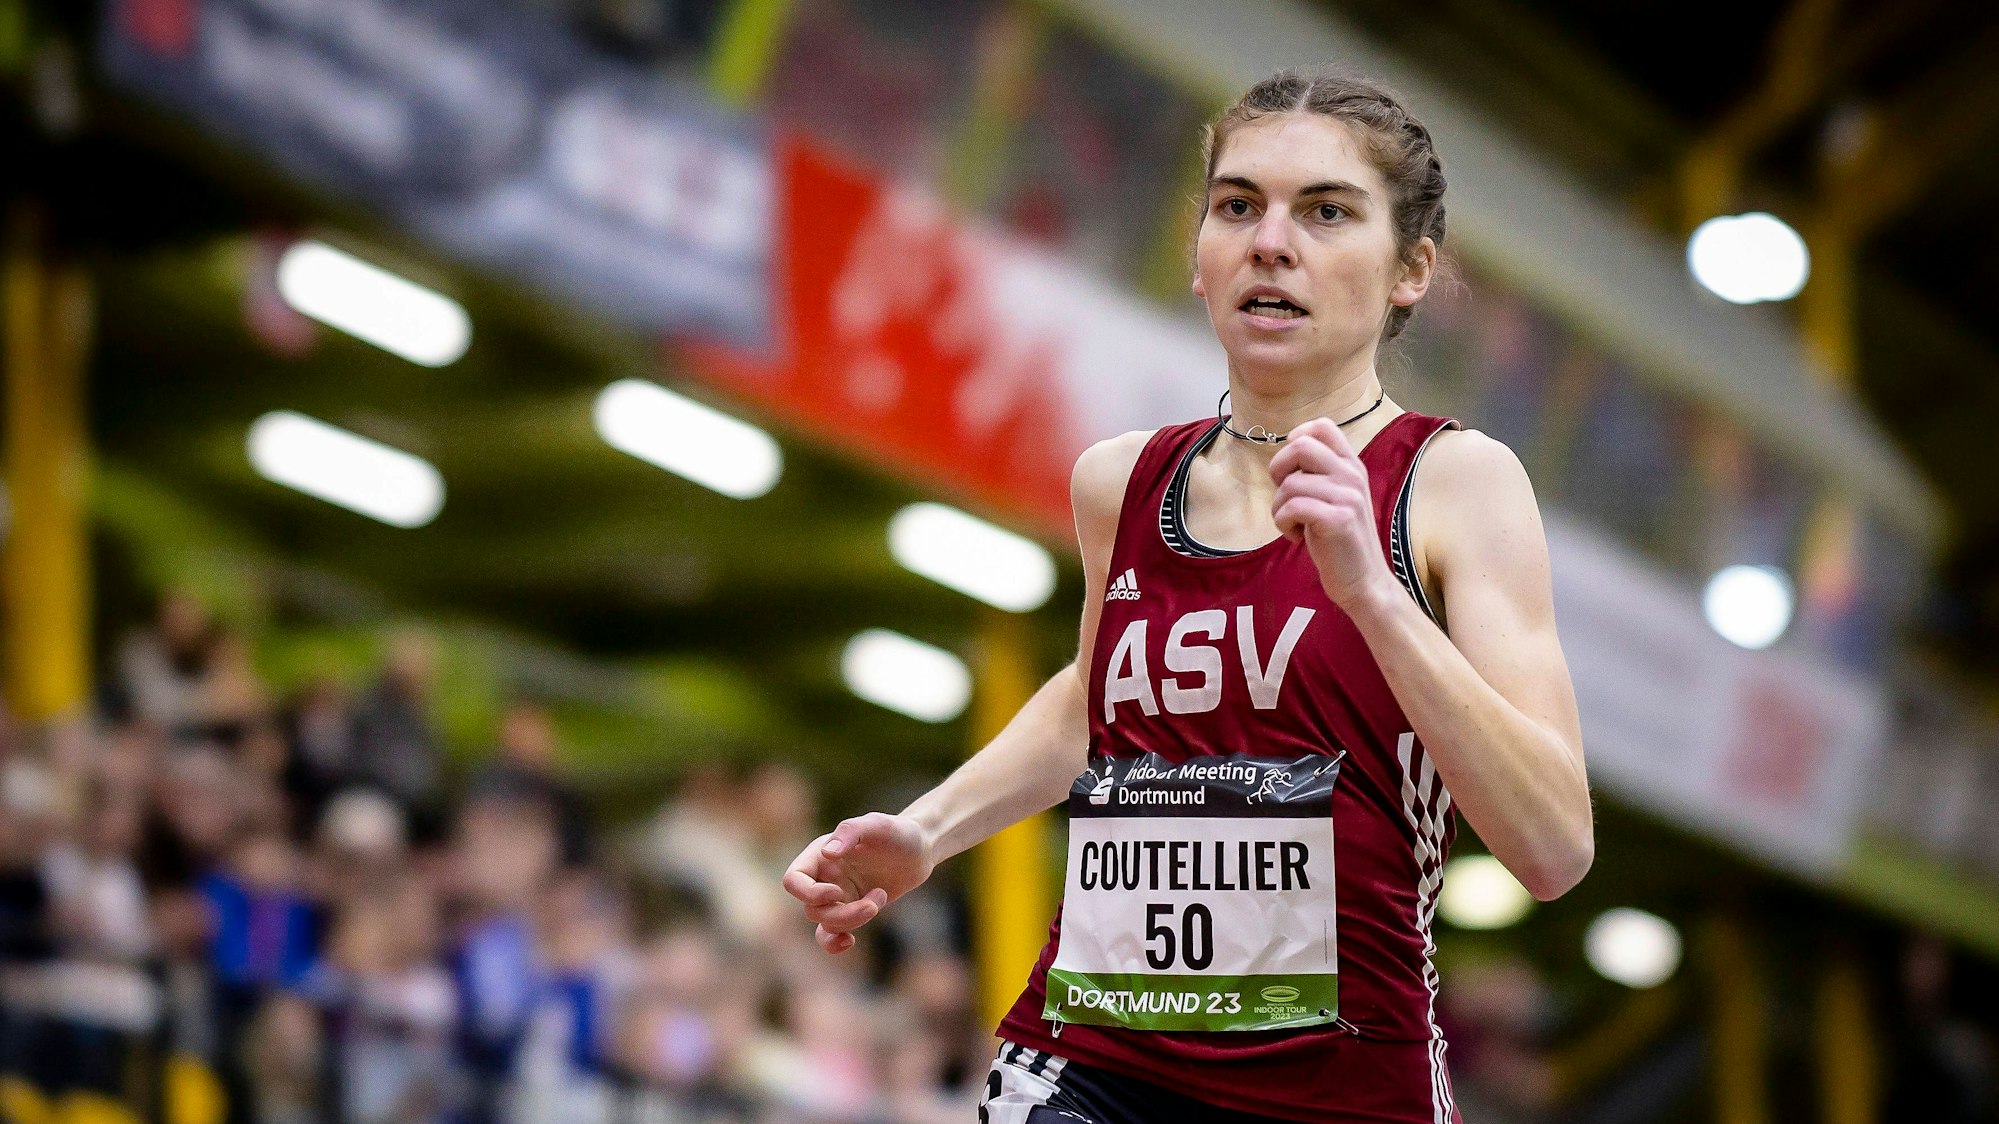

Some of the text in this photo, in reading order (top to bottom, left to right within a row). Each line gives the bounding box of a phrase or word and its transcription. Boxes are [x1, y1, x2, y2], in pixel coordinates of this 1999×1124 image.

[1105, 588, 1141, 601] adidas
[1104, 605, 1316, 724] ASV
[1179, 764, 1257, 784] Meeting
[1118, 786, 1205, 805] Dortmund
[1080, 841, 1311, 891] COUTELLIER
[1145, 903, 1214, 971] 50
[1067, 985, 1242, 1014] DORTMUND 23
[1253, 1006, 1307, 1014] INDOOR TOUR
